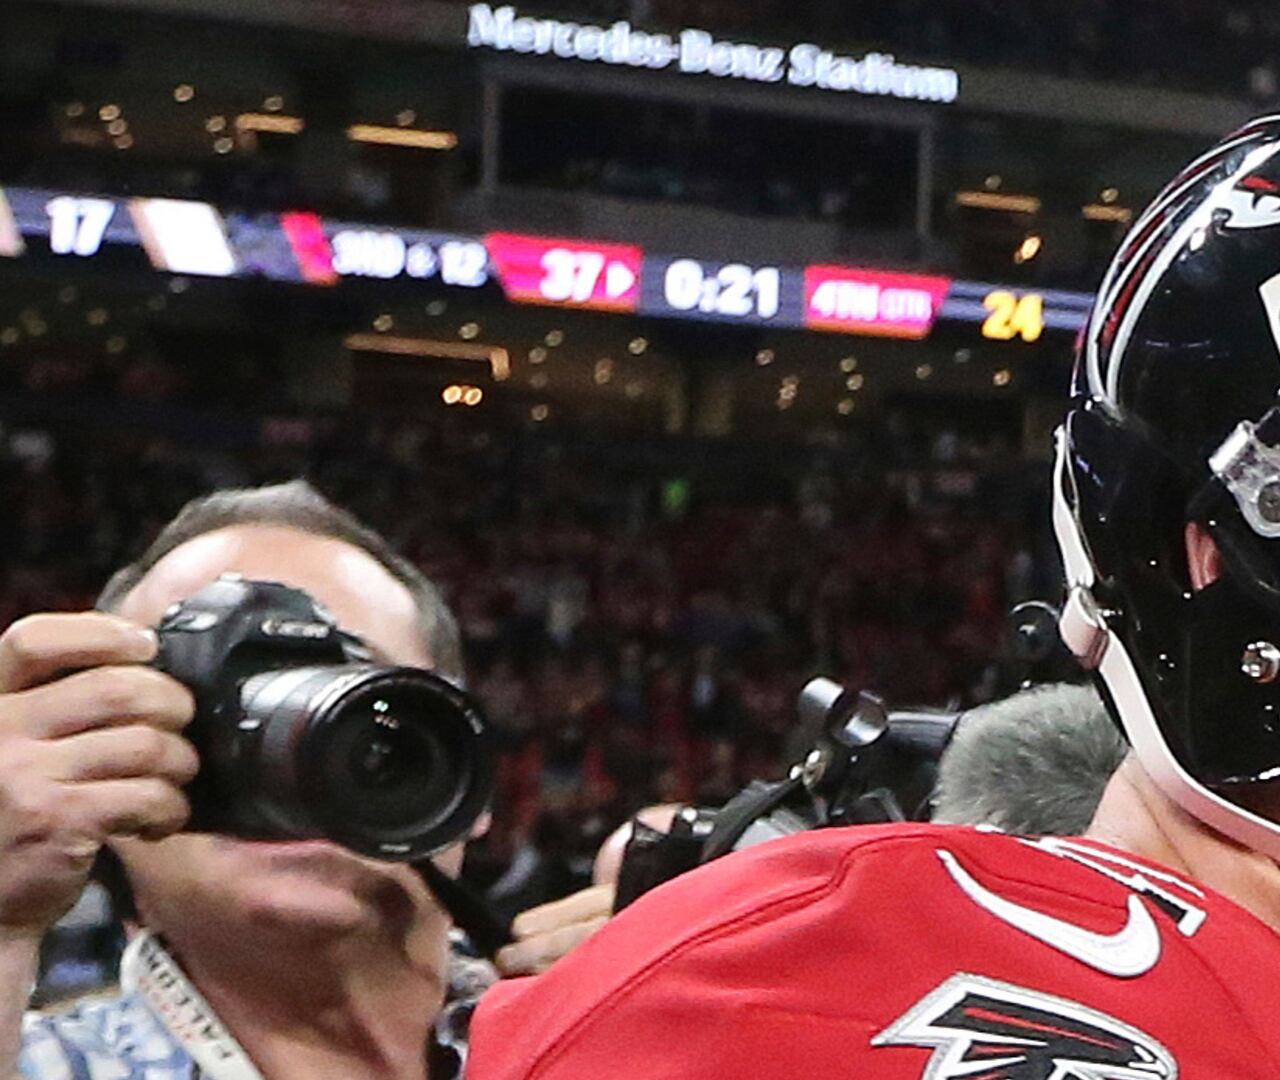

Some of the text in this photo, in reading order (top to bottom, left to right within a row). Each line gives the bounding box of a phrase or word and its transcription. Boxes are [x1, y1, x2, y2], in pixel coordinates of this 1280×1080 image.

[467, 2, 959, 103] Mercedes-Benz Stadium
[47, 197, 114, 256] 17
[440, 241, 488, 287] 12
[540, 247, 603, 301] 37
[664, 258, 780, 318] 0:21
[981, 289, 1044, 341] 24
